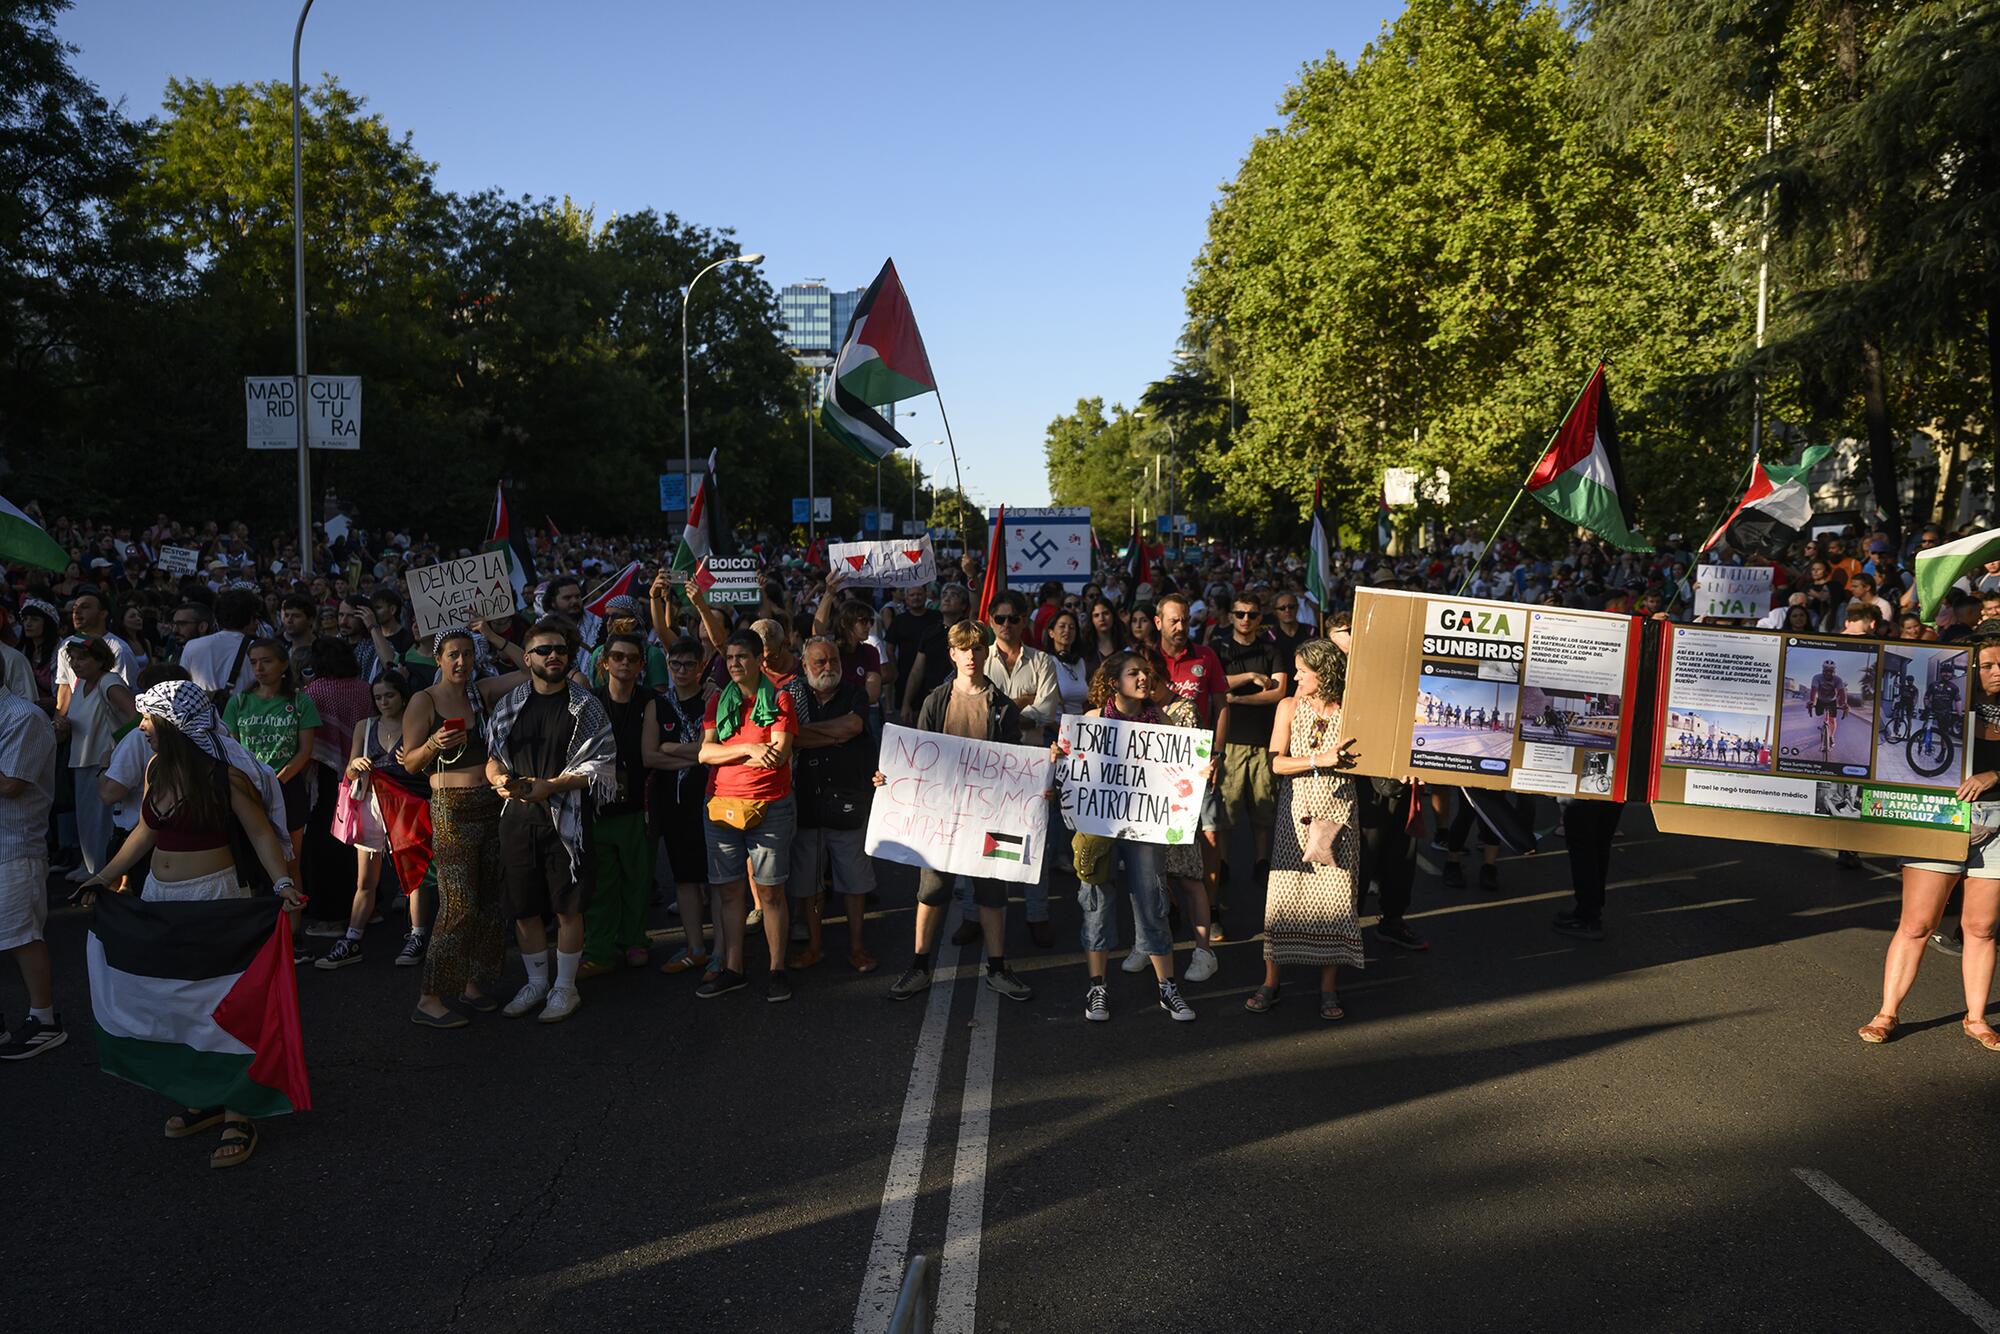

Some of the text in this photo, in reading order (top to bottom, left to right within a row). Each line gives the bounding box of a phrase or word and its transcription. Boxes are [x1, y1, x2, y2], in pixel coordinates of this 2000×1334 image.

[249, 382, 294, 399] MAD
[310, 382, 351, 400] CUL
[266, 400, 295, 417] RID
[317, 401, 344, 418] TU
[331, 419, 357, 436] RA
[483, 556, 504, 580] LA
[709, 558, 756, 570] BOICOT
[428, 586, 485, 608] VUELTA
[709, 589, 760, 602] ISRAELÍ
[1440, 609, 1510, 636] GAZA
[1423, 638, 1524, 661] SUNBIRDS
[1531, 657, 1568, 665] PARALÍMPICO
[1675, 667, 1724, 675] FRANCOTIRADOR
[1074, 723, 1118, 758] ISRAEL
[894, 735, 1044, 785] NO HABRÁ
[1070, 759, 1147, 788] LA VUELTA
[1738, 788, 1780, 797] tratamiento
[1782, 791, 1808, 799] médico
[1872, 790, 1958, 805] NINGUNA BOMBA
[889, 775, 1048, 830] CICLISMO
[1077, 787, 1170, 826] PATROCINA
